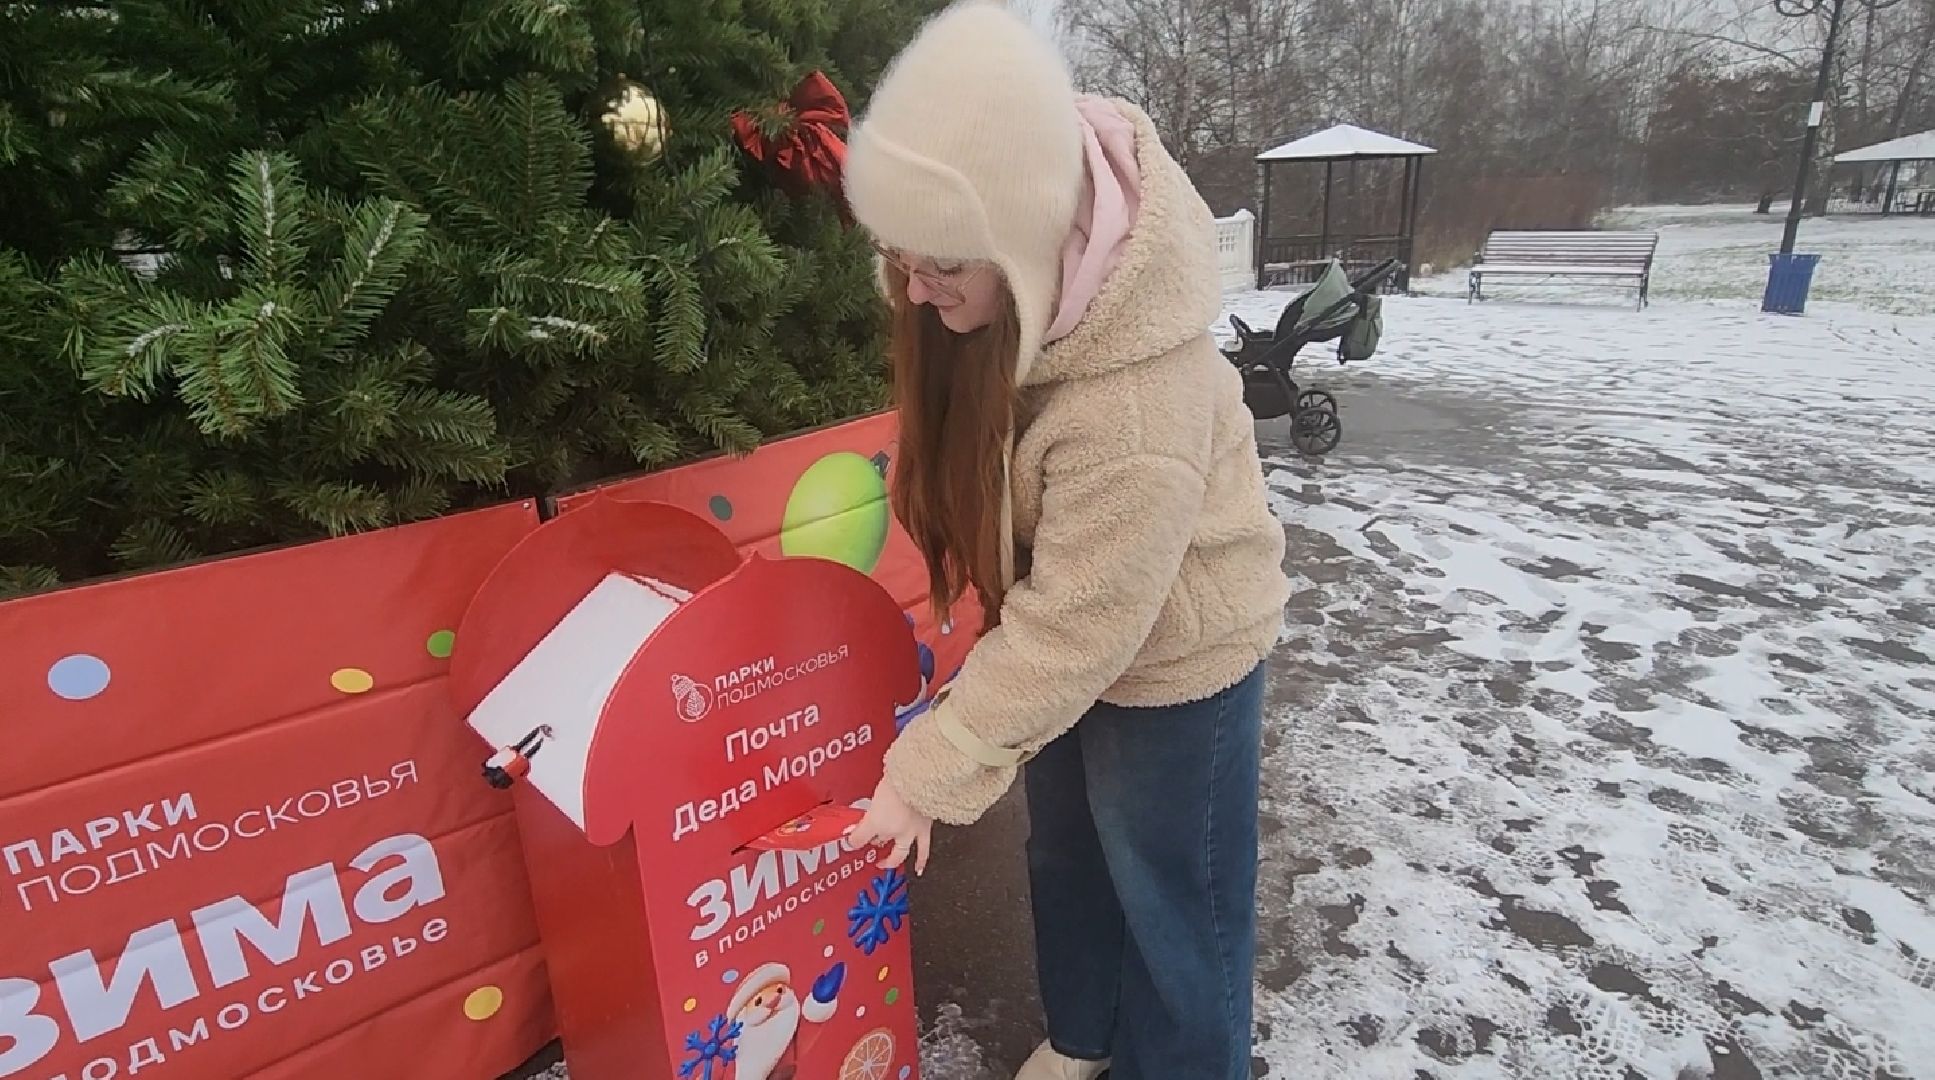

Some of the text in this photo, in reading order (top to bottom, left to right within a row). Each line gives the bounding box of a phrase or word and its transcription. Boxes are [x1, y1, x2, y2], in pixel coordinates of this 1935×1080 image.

[715, 656, 775, 692] ПАРКИ
[717, 644, 849, 710] ПОДМОСКОВЬЯ
[672, 723, 873, 842] Деда Мороза
[725, 704, 820, 762] Почта
[3, 792, 198, 875] ПАРКИ
[17, 760, 419, 911] ПОДМОСКОВЬЯ
[687, 798, 873, 941] зим
[50, 918, 449, 1080] одмосковье
